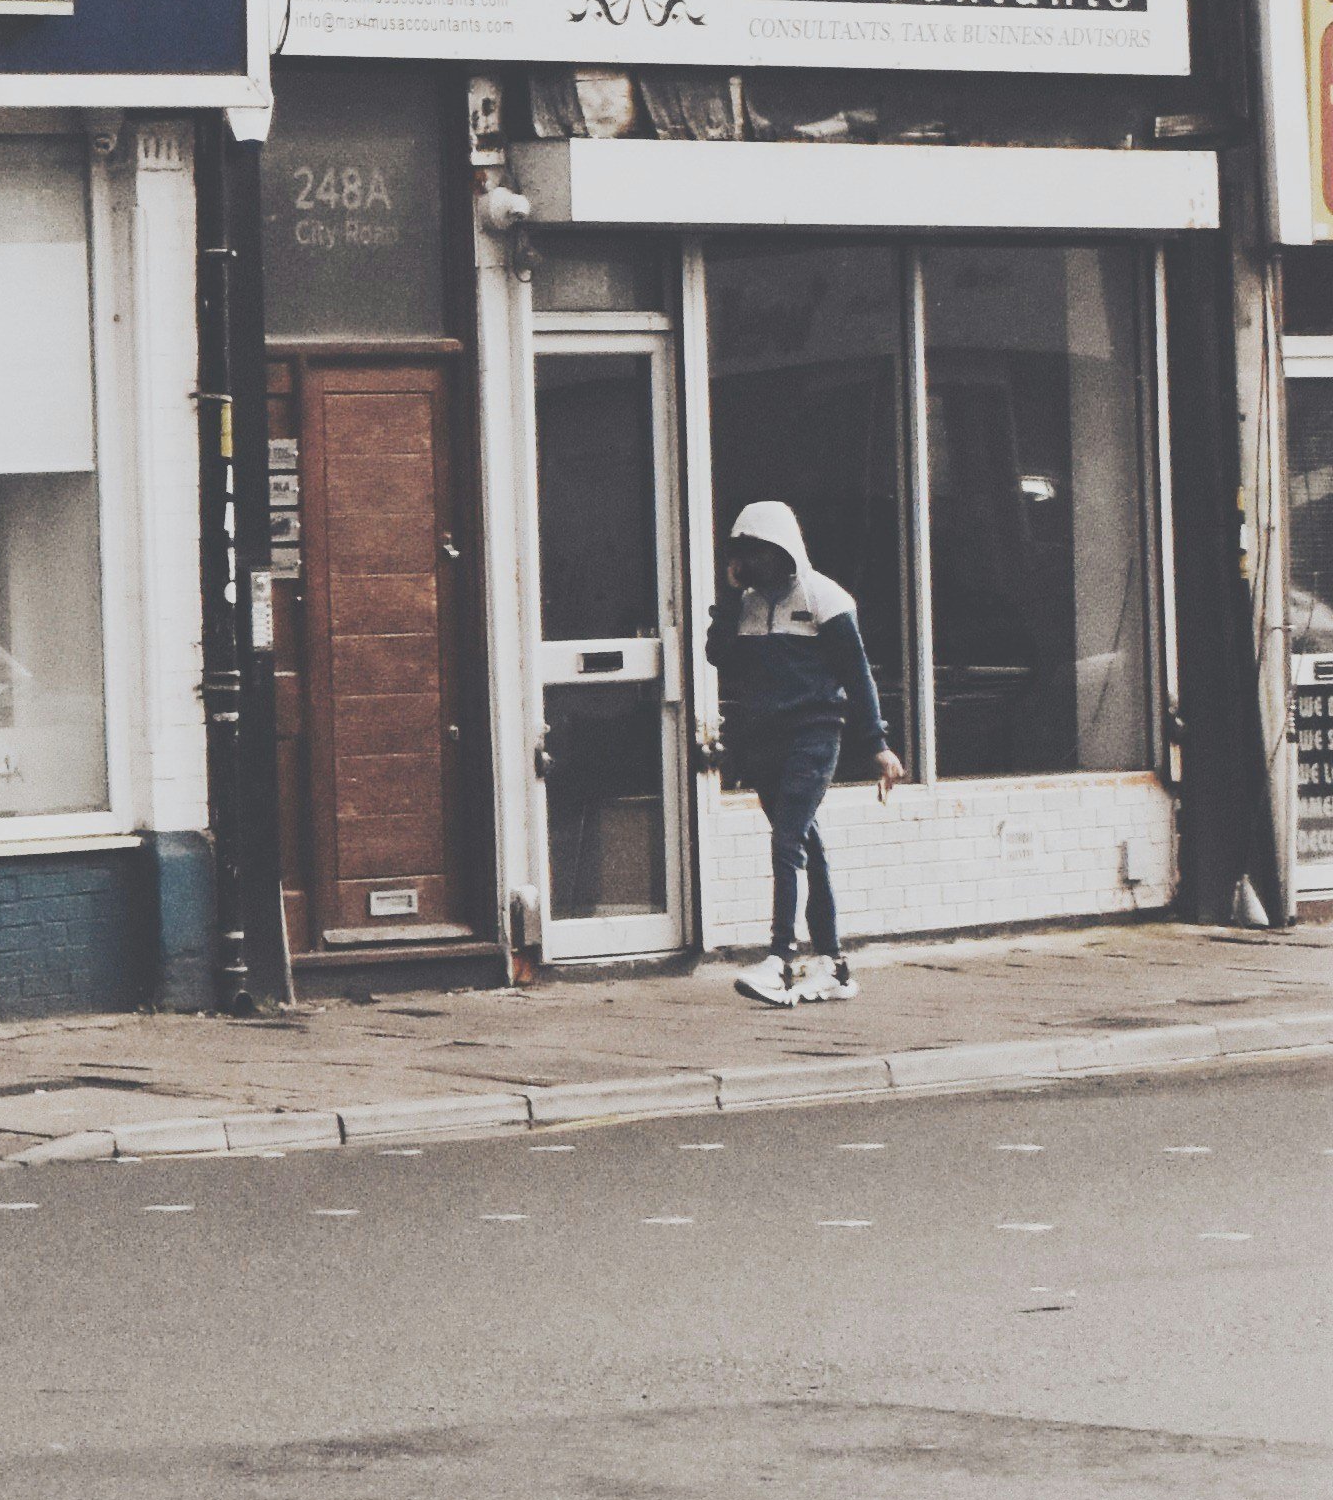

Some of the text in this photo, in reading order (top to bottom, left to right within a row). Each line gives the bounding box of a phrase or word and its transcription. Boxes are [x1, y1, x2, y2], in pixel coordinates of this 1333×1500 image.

[295, 11, 515, 34] info@maximusaccountants.com
[901, 21, 938, 43] TAX
[943, 26, 958, 44] &
[962, 24, 1054, 46] BUSINESS
[1057, 26, 1151, 48] ADVISORS
[293, 166, 391, 210] 248A
[295, 219, 336, 248] City
